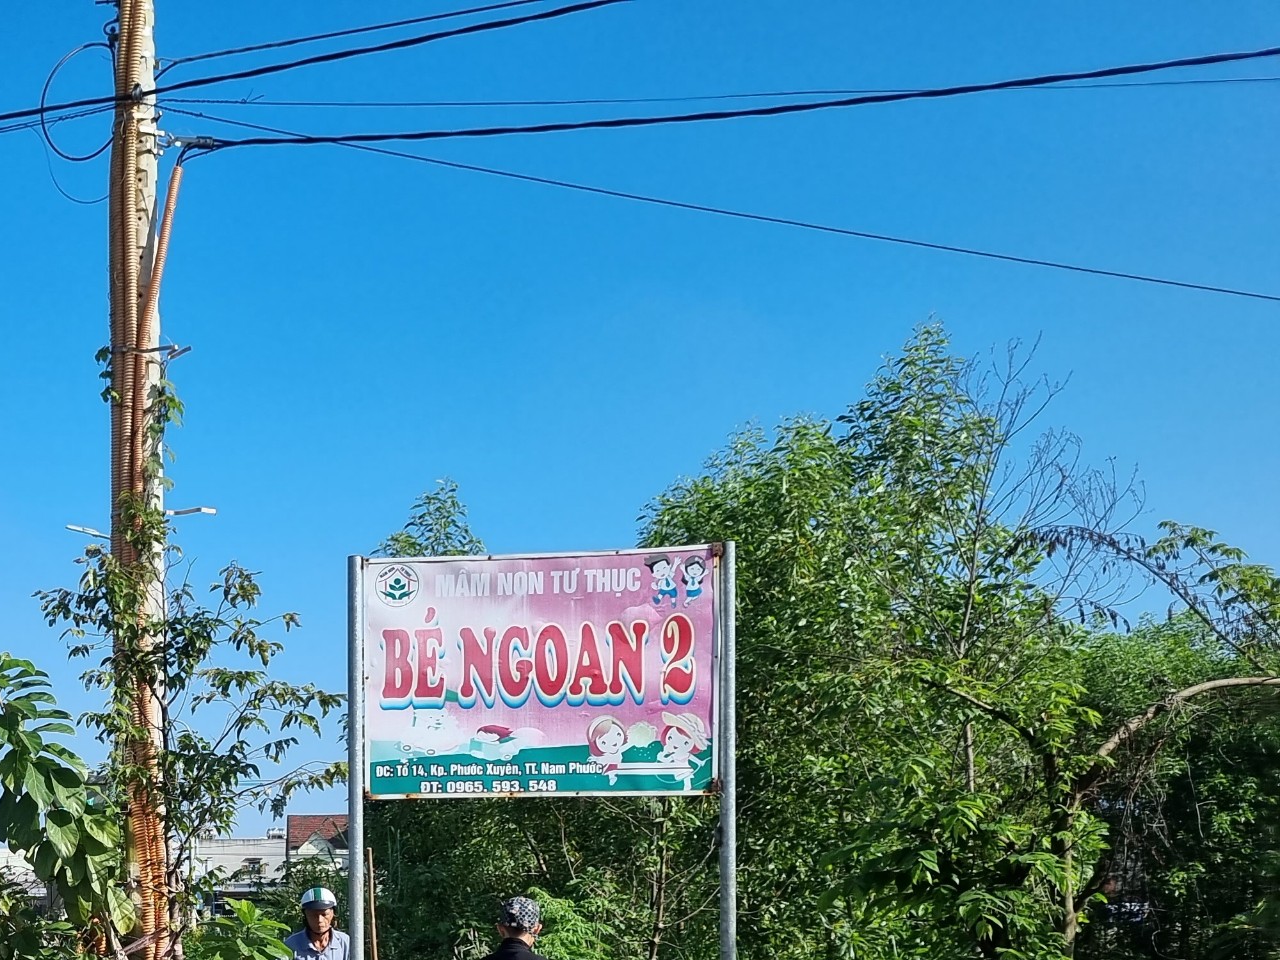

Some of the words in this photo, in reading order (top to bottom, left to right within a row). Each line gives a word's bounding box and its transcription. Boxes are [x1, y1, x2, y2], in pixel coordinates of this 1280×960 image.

[497, 571, 544, 596] NON
[550, 568, 581, 594] TƯ
[584, 566, 642, 598] THỤC
[380, 607, 446, 706] BÉ
[458, 621, 649, 708] NGOAN
[661, 613, 696, 704] 2
[375, 765, 394, 778] ĐC:
[412, 765, 428, 778] 14,
[430, 764, 448, 778] Kp.
[450, 763, 484, 776] Phước
[486, 763, 522, 777] Xuyên,
[525, 763, 538, 775] TT.
[541, 763, 566, 775] Nam
[569, 762, 603, 775] Phước
[420, 781, 442, 793] ĐT:
[447, 781, 487, 793] 0965.
[492, 780, 524, 792] 593.
[528, 779, 557, 792] 548
